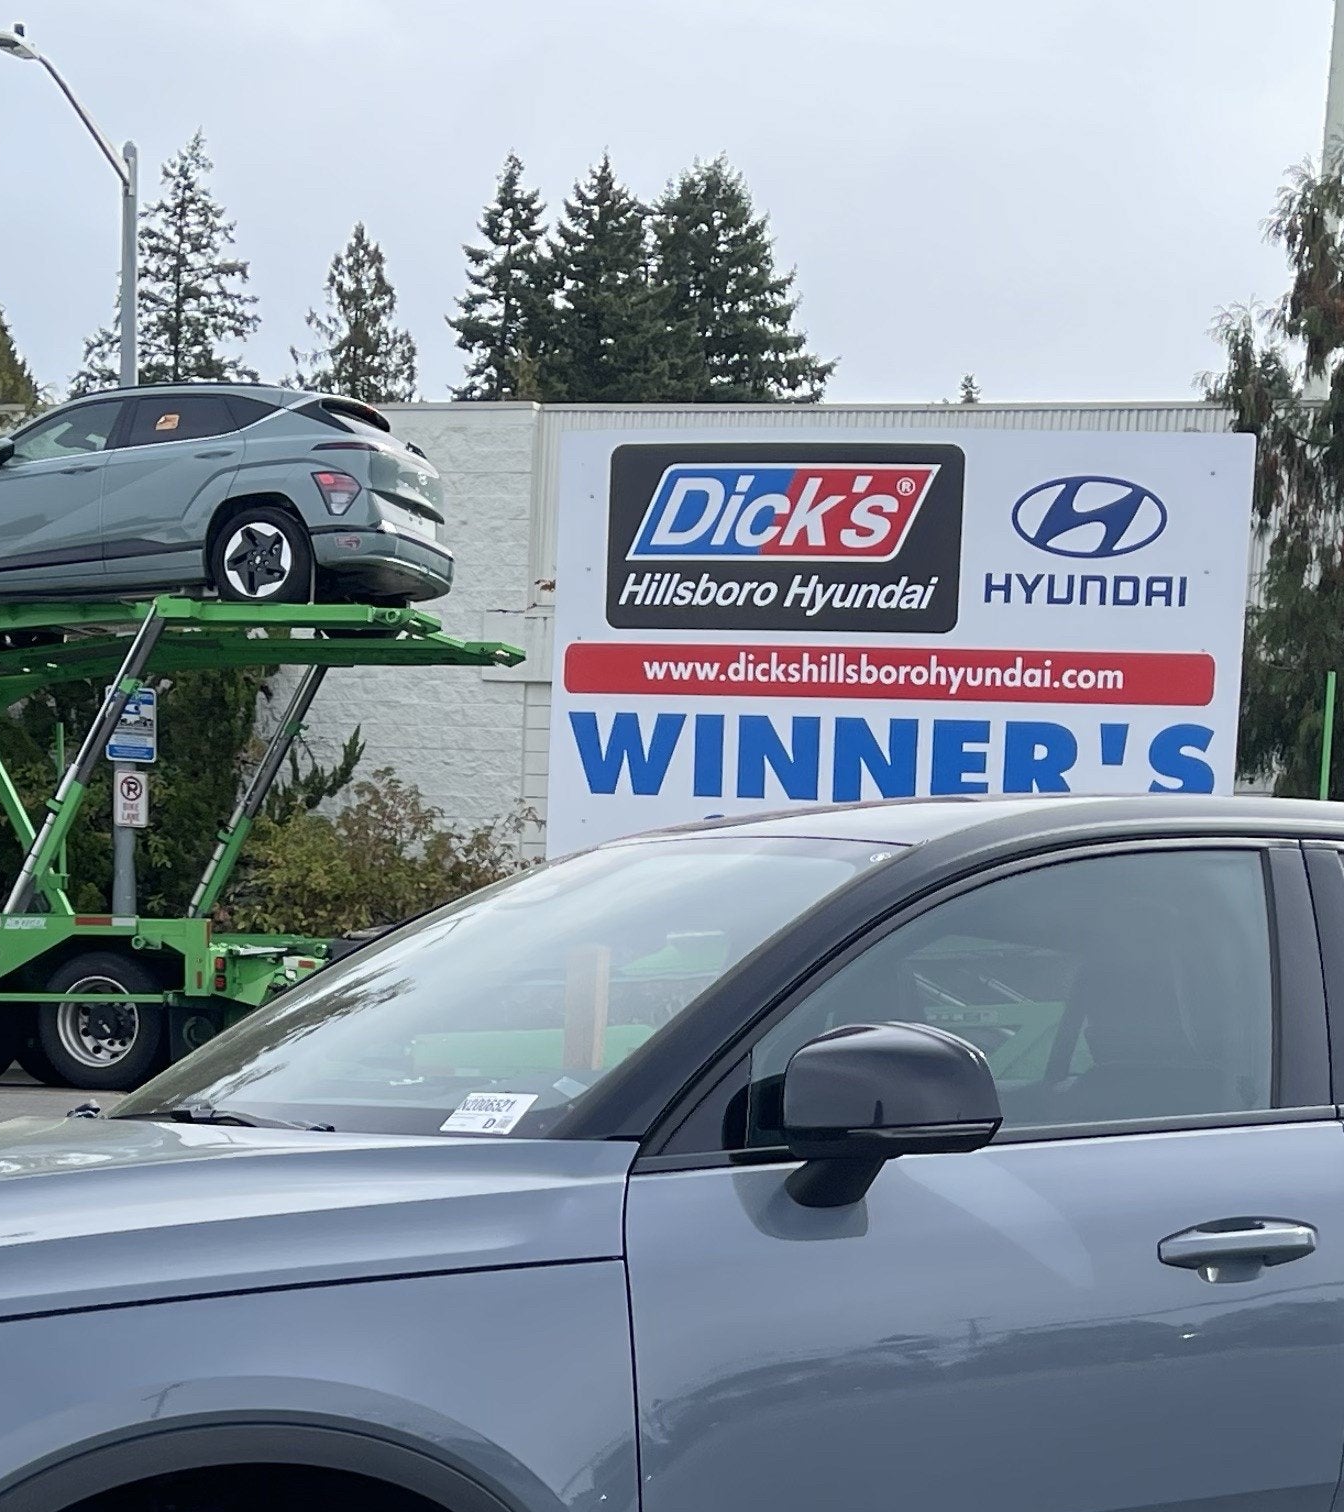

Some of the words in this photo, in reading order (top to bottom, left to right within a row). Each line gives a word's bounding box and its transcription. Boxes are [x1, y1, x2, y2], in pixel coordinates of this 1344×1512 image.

[649, 476, 901, 547] Dick's
[618, 573, 778, 608] Hillsboro
[783, 574, 939, 616] Hyundai
[984, 573, 1188, 607] HYUNDAI
[643, 653, 1124, 694] www.dickshillsborohyundai.com
[569, 711, 1215, 802] WINNER'S
